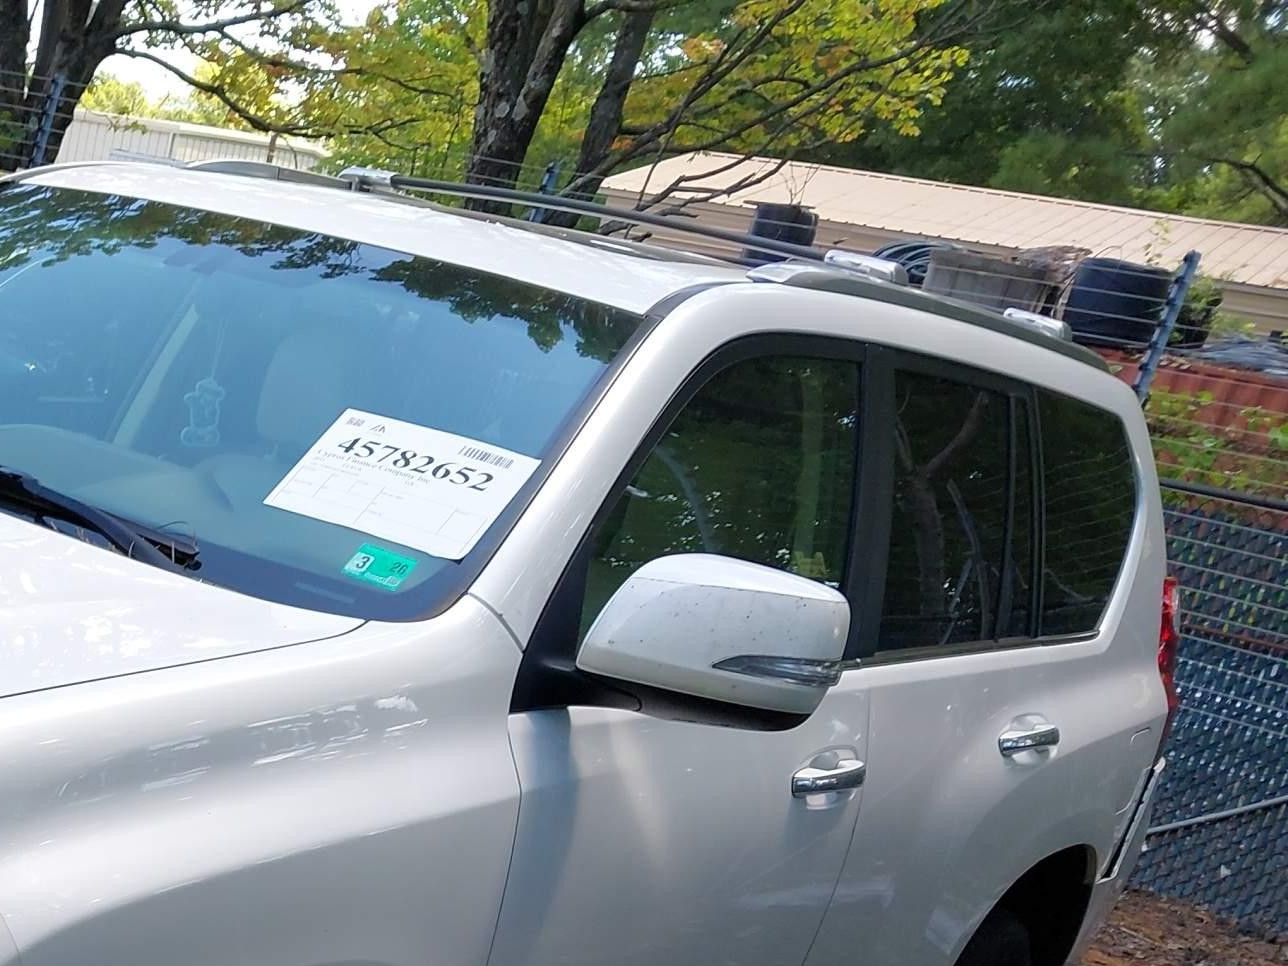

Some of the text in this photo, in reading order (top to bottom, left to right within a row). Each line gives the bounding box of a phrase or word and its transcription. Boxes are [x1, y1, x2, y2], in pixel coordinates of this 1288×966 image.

[337, 437, 494, 492] 45782652
[355, 556, 409, 575] 3 26
